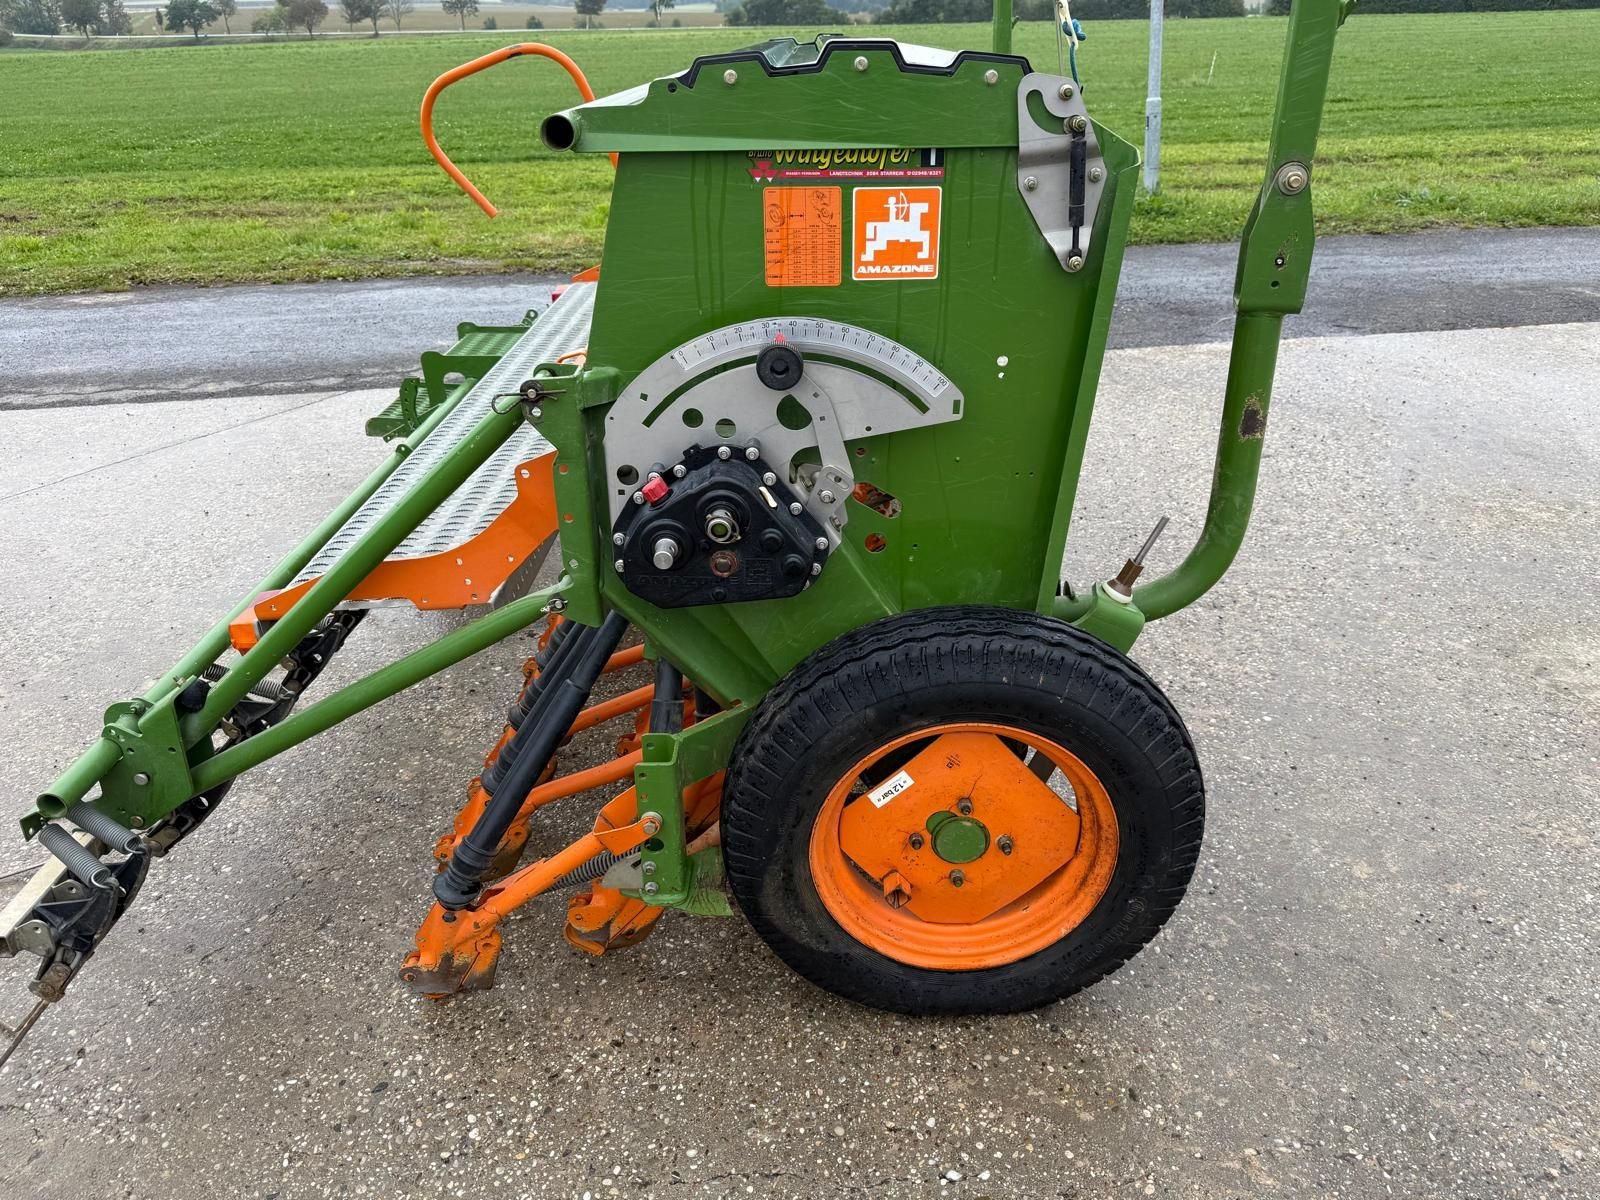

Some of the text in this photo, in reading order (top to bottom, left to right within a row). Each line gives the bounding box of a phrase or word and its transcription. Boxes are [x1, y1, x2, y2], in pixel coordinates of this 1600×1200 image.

[857, 264, 935, 274] AMAZONE
[706, 335, 714, 343] 10
[733, 326, 743, 334] 20
[815, 321, 824, 329] 50
[841, 326, 850, 334] 60
[867, 334, 876, 342] 70
[891, 344, 900, 353] 80
[915, 359, 924, 368] 90
[937, 376, 948, 387] 100
[881, 789, 895, 800] bar
